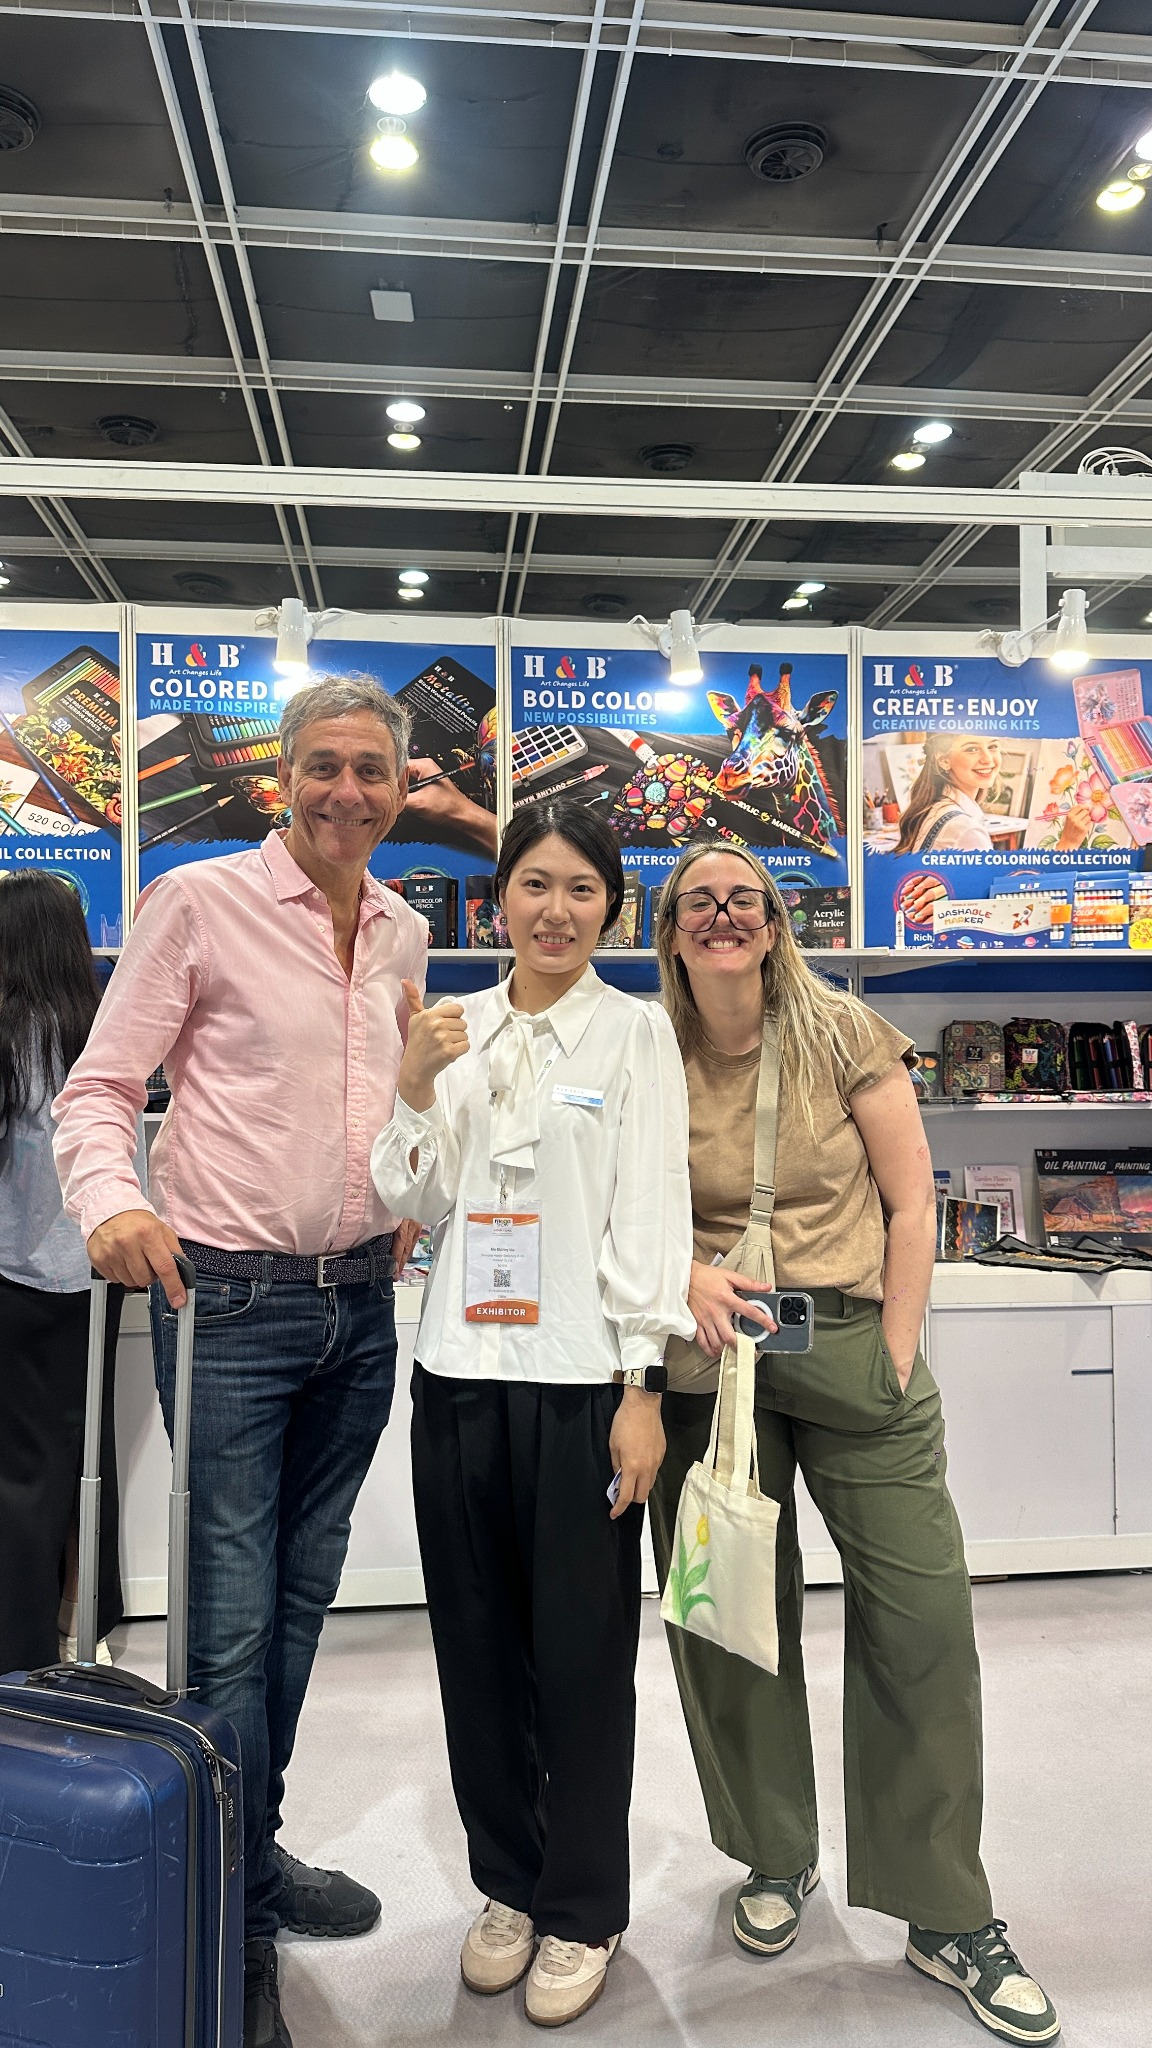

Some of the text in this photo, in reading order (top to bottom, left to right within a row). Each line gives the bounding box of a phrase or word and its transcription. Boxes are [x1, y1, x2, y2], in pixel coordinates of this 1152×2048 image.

[151, 642, 174, 666] H
[185, 643, 208, 667] &
[182, 669, 208, 677] Changes
[523, 655, 545, 678] H
[555, 655, 576, 679] &
[873, 664, 894, 686] H
[904, 664, 925, 687] &
[149, 677, 268, 700] COLORED
[552, 680, 578, 688] Changes
[423, 673, 475, 714] Metallic
[901, 688, 926, 696] Changes
[523, 689, 586, 709] BOLD
[70, 688, 118, 728] PREMIUM
[150, 698, 278, 714] MADE TO INSPIRE
[524, 711, 657, 725] NEW POSSIBILITIES
[872, 718, 1041, 731] CREATIVE COLORING KITS
[536, 782, 566, 800] OUTLINE
[28, 812, 48, 825] 520
[52, 820, 96, 835] COLO
[771, 818, 802, 838] MARKER
[15, 848, 111, 860] COLLECTION
[922, 854, 1131, 866] CREATIVE COLORING COLLECTION
[768, 856, 812, 866] PAINTS
[813, 909, 845, 919] Acrylic
[938, 908, 992, 919] WASHABLE
[944, 917, 984, 925] MARKER
[914, 934, 935, 943] Rich,
[1044, 1161, 1107, 1171] OIL PAINTING
[1114, 1162, 1150, 1170] PAINTING
[476, 1308, 526, 1316] EXHIBITOR
